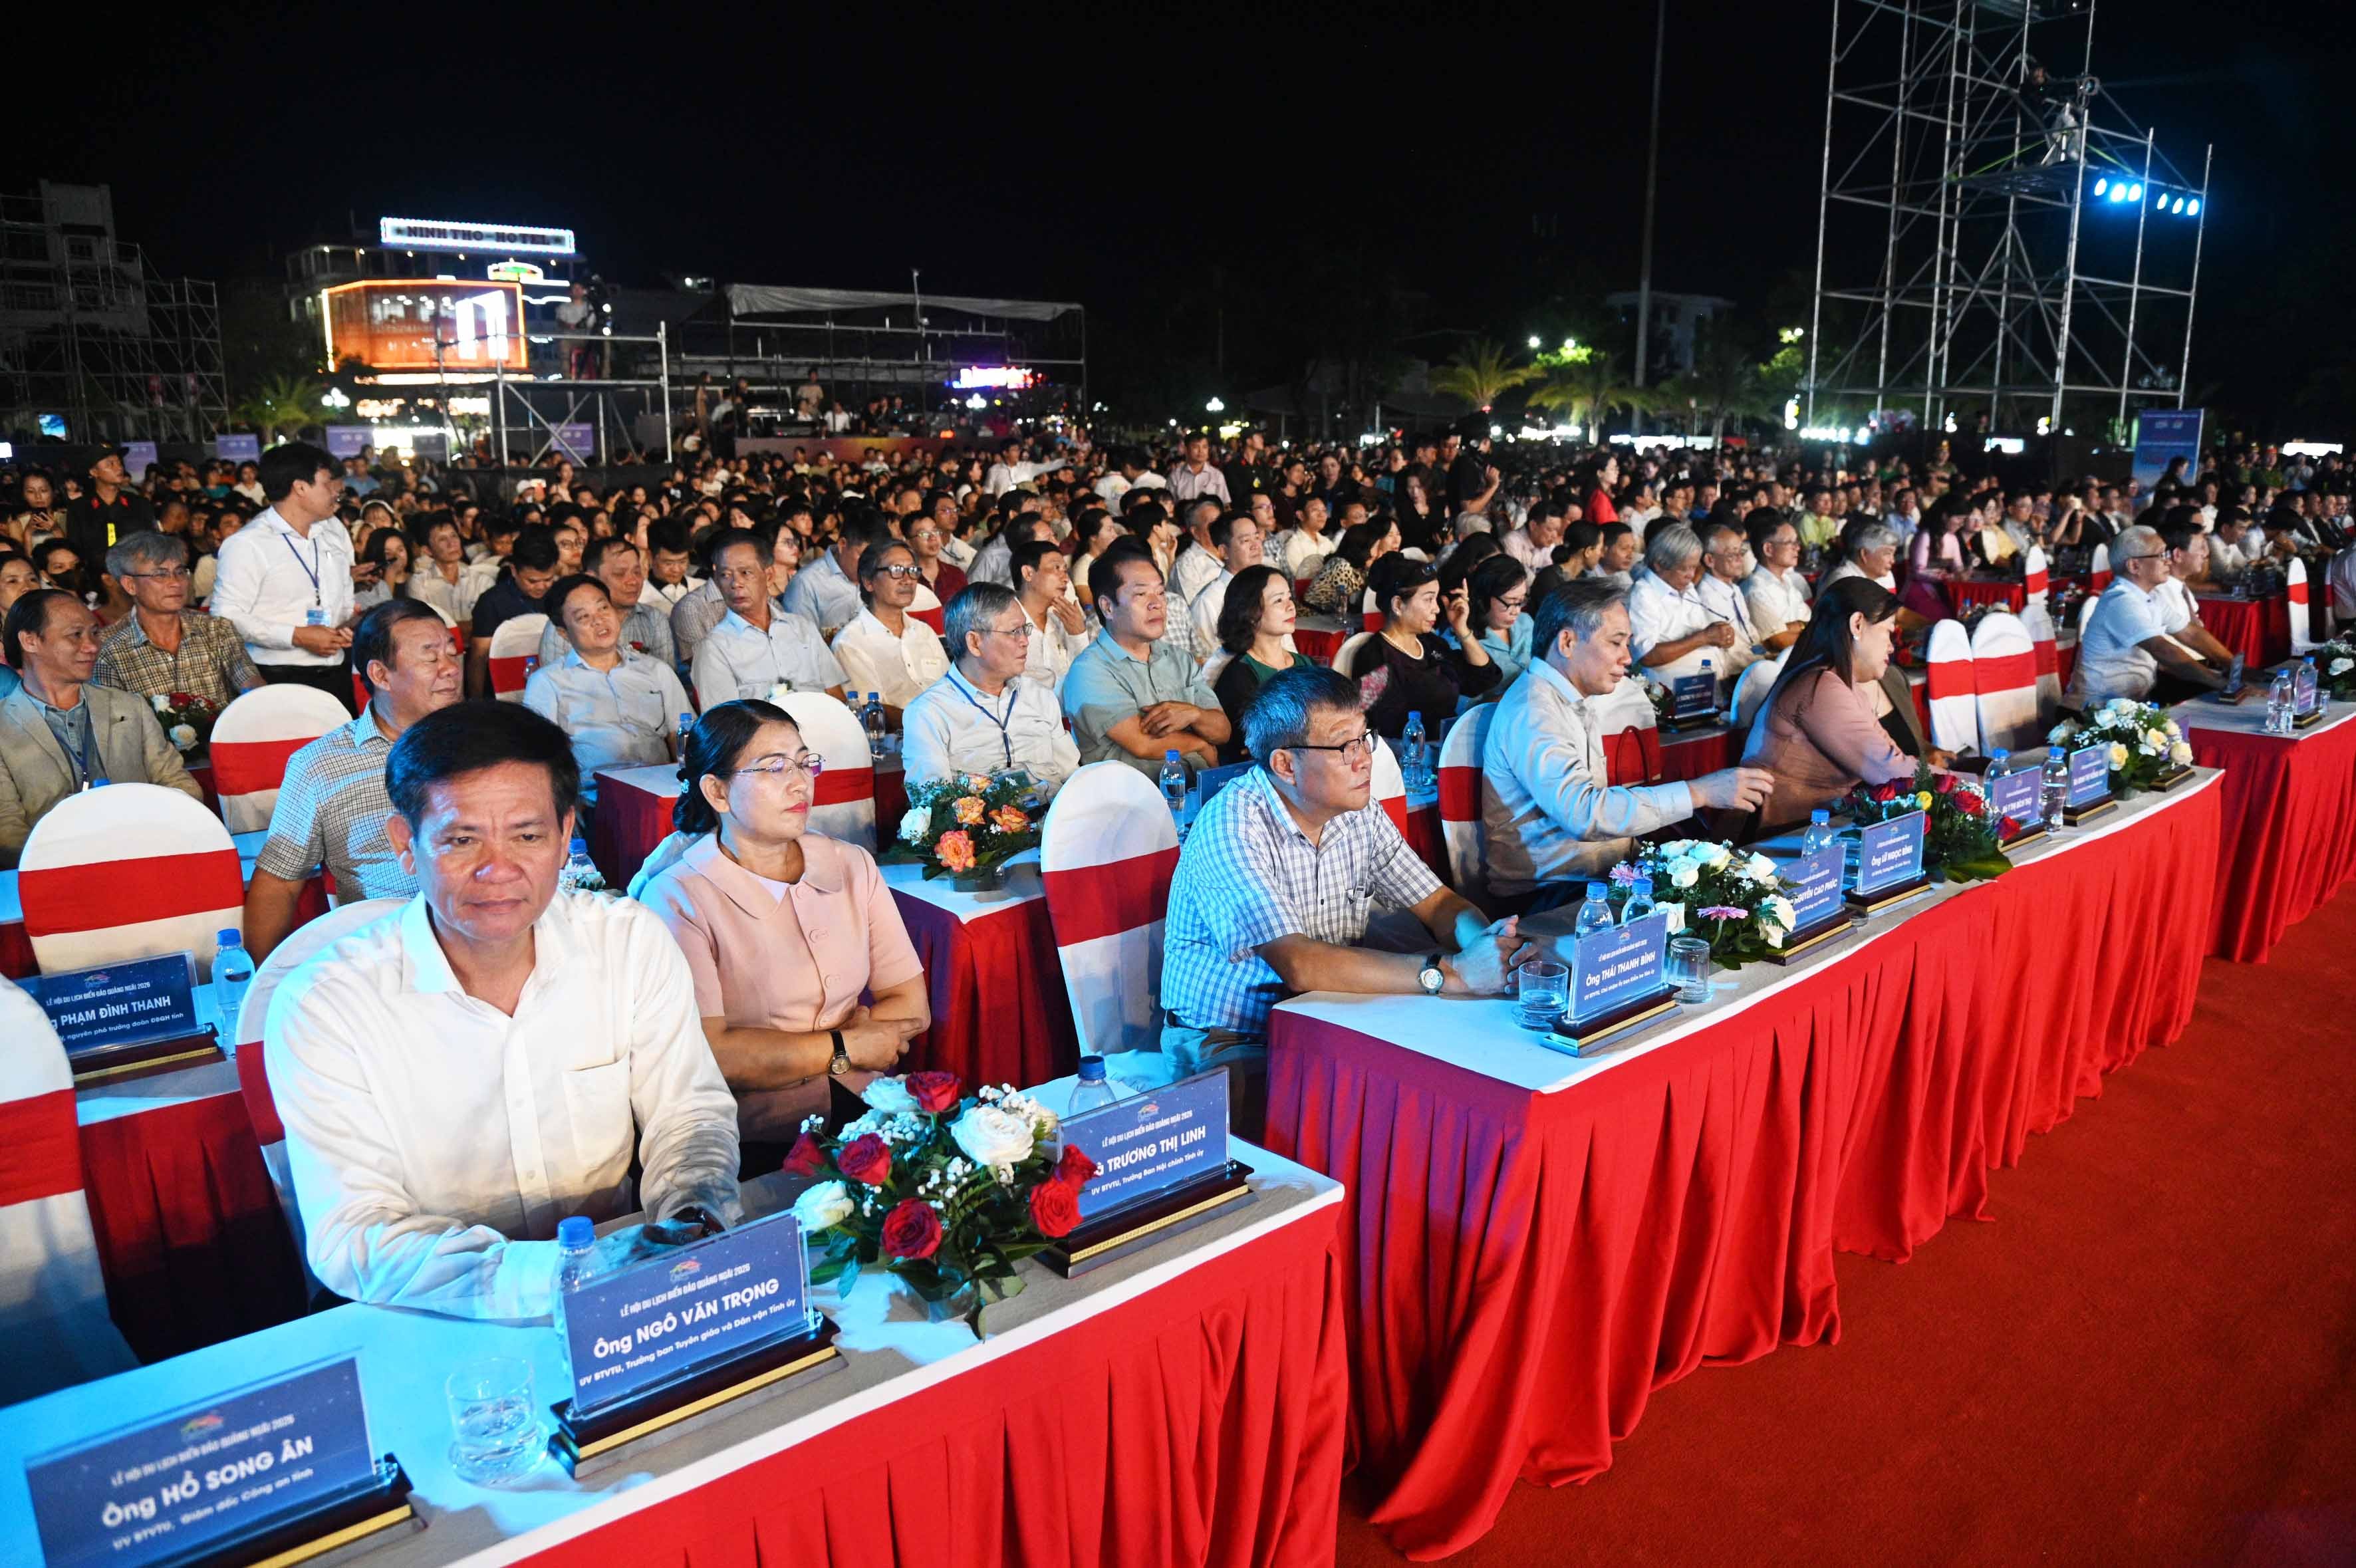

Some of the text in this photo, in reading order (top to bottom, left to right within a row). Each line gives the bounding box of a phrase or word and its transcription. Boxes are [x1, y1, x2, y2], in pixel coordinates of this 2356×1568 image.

[407, 225, 448, 239] NINH
[495, 231, 550, 245] HOTEL
[1585, 951, 1655, 986] Ông THÁI THANH BÌNH
[60, 1009, 96, 1025] PHẠM
[99, 1003, 128, 1018] ĐÌNH
[130, 996, 170, 1013] THANH
[67, 1030, 92, 1039] nguyên
[1107, 1144, 1156, 1171] TRƯƠNG
[1159, 1136, 1177, 1152] THỊ
[1181, 1126, 1206, 1144] LINH
[594, 1278, 779, 1358] Ông NGÔ VĂN TRỌNG
[580, 1375, 591, 1386] UV
[656, 1345, 673, 1356] ban
[674, 1335, 699, 1349] Tuyên
[700, 1329, 720, 1341] giáo
[733, 1317, 750, 1327] Dân
[752, 1310, 767, 1319] vận
[102, 1435, 313, 1526] Ông HỒ SONG ÂN
